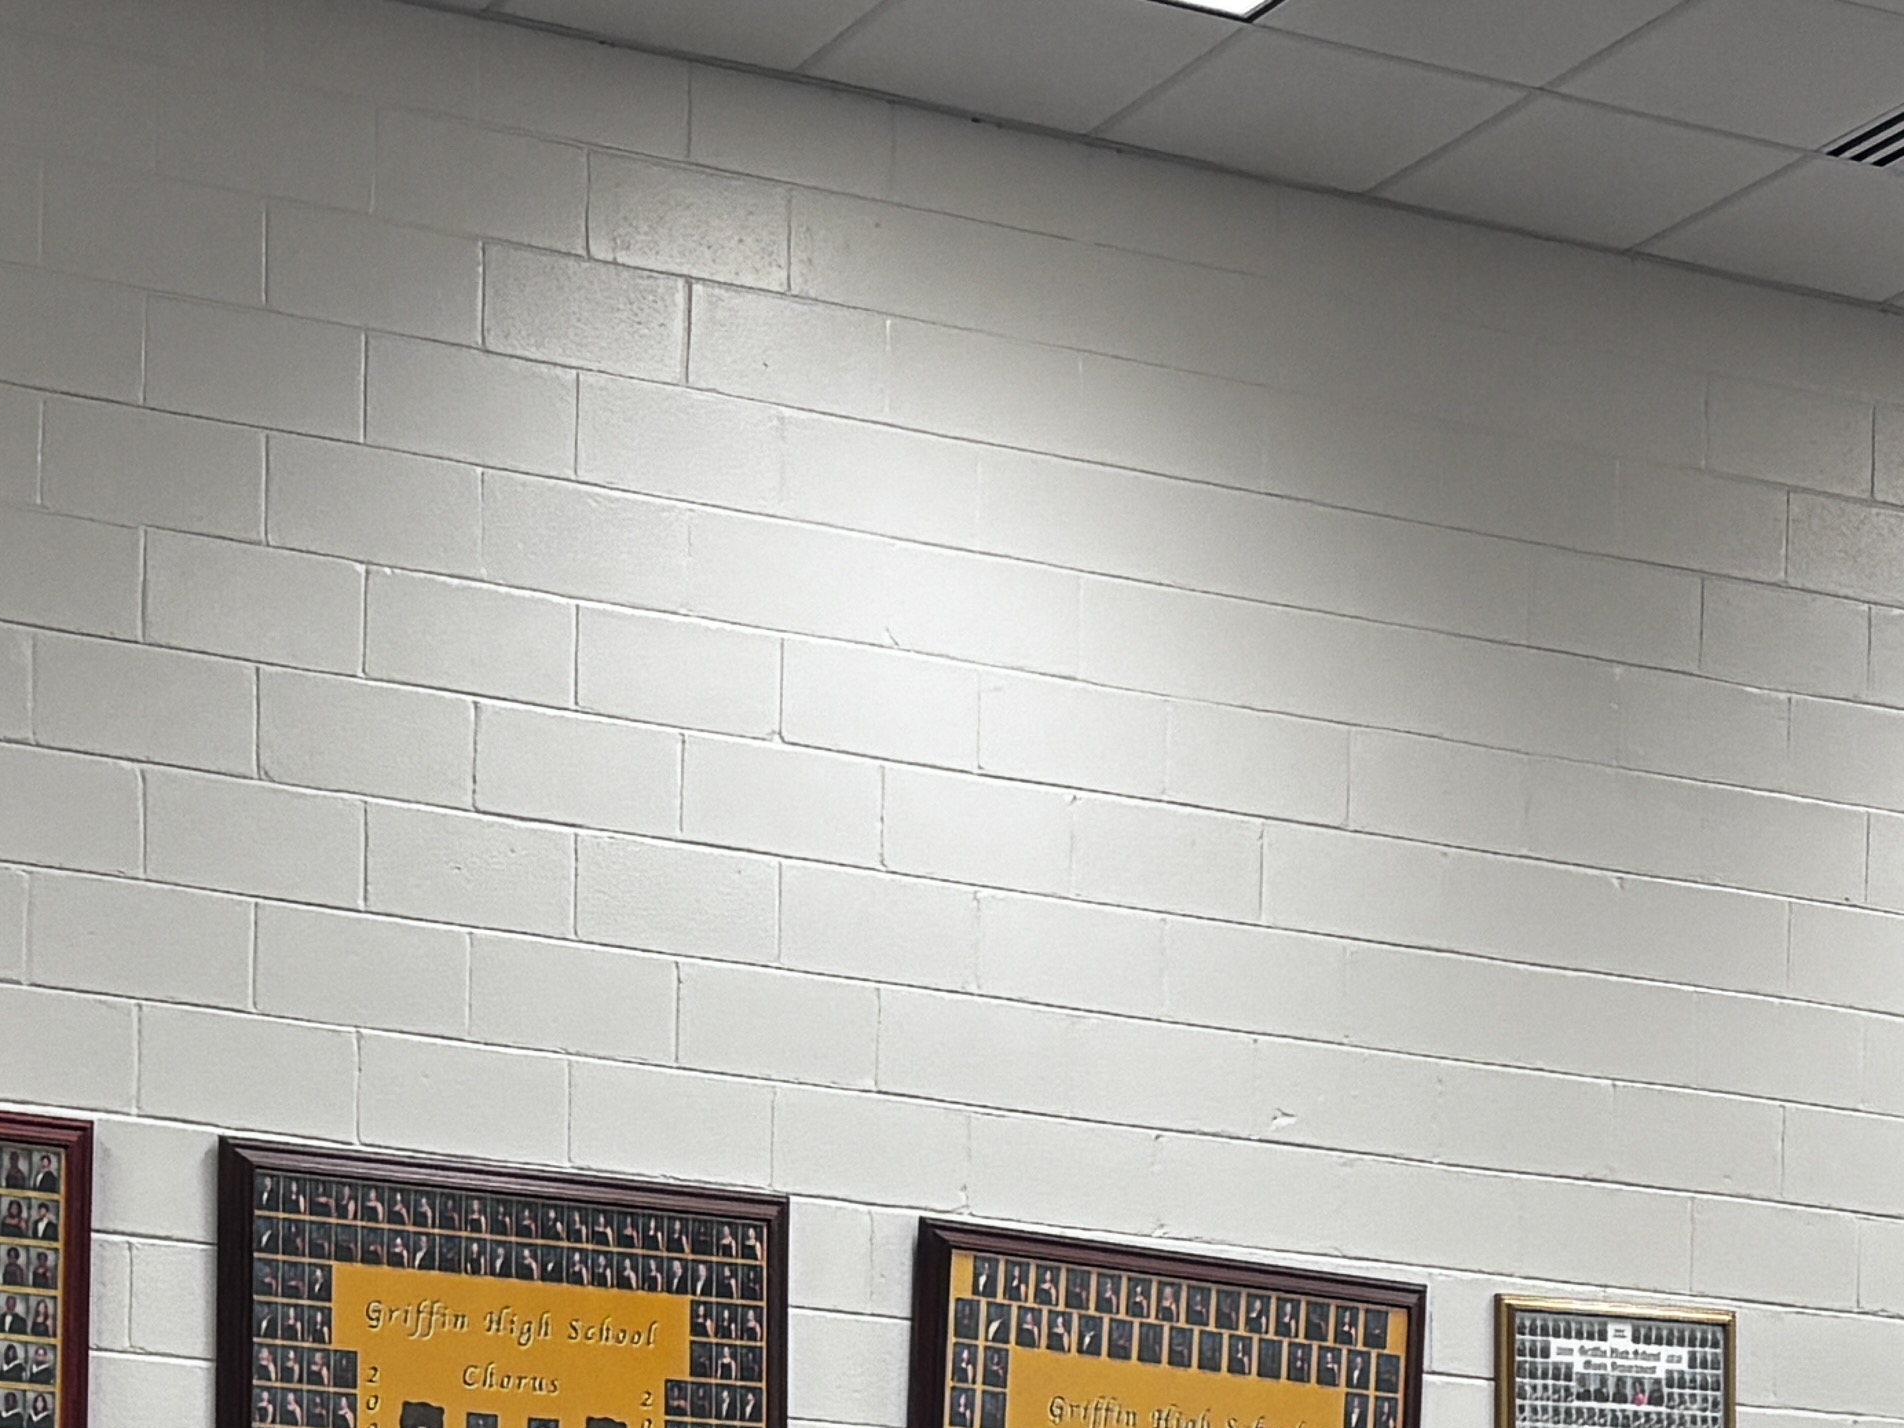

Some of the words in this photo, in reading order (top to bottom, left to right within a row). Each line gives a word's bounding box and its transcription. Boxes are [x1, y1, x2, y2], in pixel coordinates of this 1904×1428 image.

[365, 1299, 471, 1341] Griffin
[483, 1305, 553, 1349] High
[567, 1315, 661, 1349] School
[462, 1361, 561, 1396] Chorus
